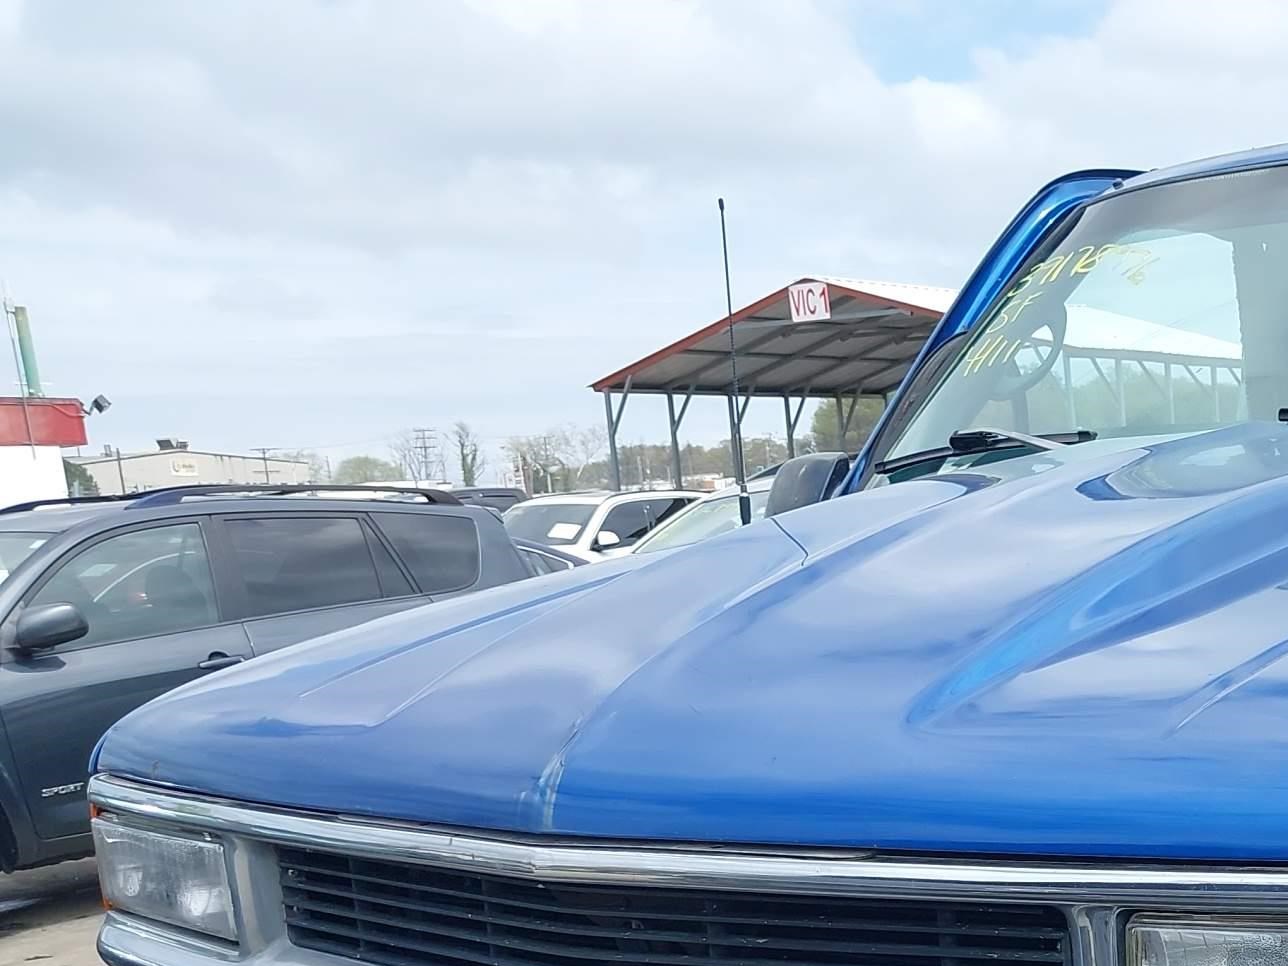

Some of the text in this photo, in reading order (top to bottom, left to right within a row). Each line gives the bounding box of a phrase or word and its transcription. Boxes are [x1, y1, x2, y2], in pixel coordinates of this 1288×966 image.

[790, 286, 829, 317] VIC 1
[40, 781, 85, 798] SPORT
